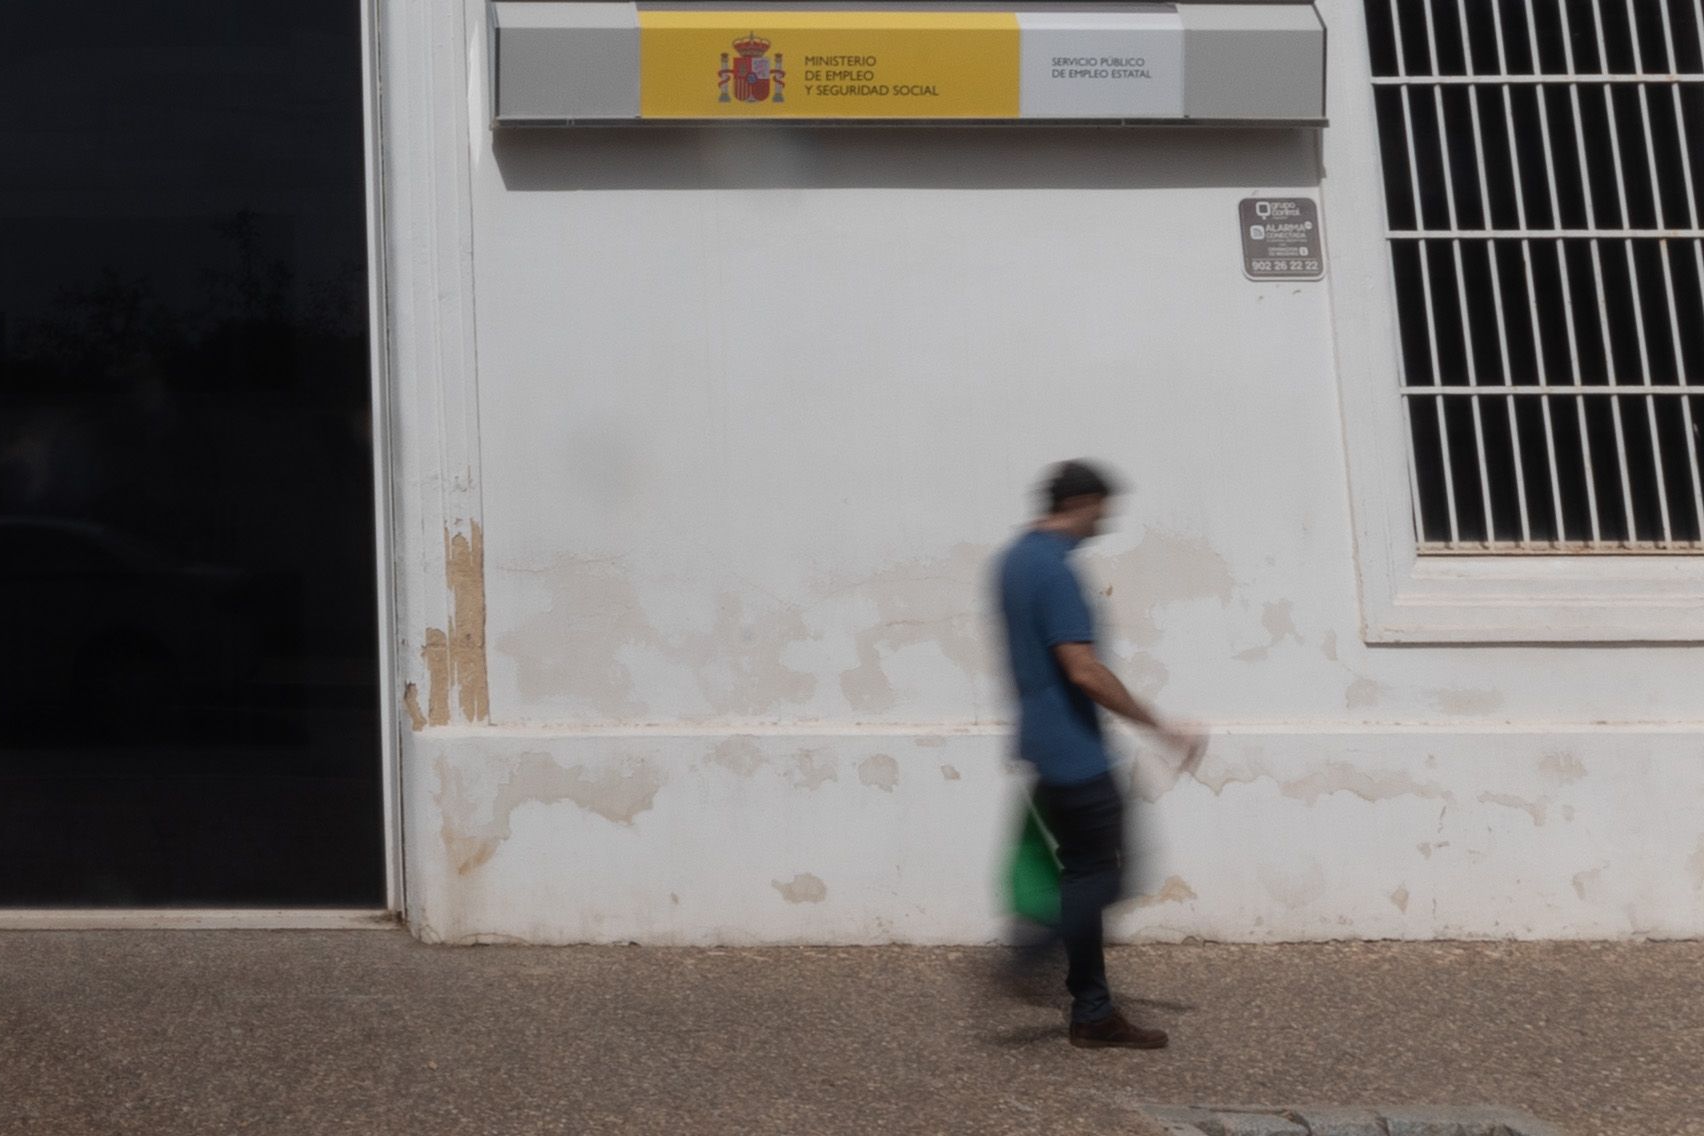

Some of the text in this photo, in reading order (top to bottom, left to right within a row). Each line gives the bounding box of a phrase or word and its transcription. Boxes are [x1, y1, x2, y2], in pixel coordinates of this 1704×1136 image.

[804, 55, 877, 67] MINISTERIO
[1051, 57, 1098, 67] SERVICIO
[804, 70, 874, 81] DE EMPLEO
[1051, 69, 1152, 79] DE EMPLEO ESTATAL
[804, 85, 939, 96] Y SEGURIDAD SOCIAL
[1265, 224, 1306, 232] ALARMA
[1252, 261, 1319, 270] 902 26 22 22
